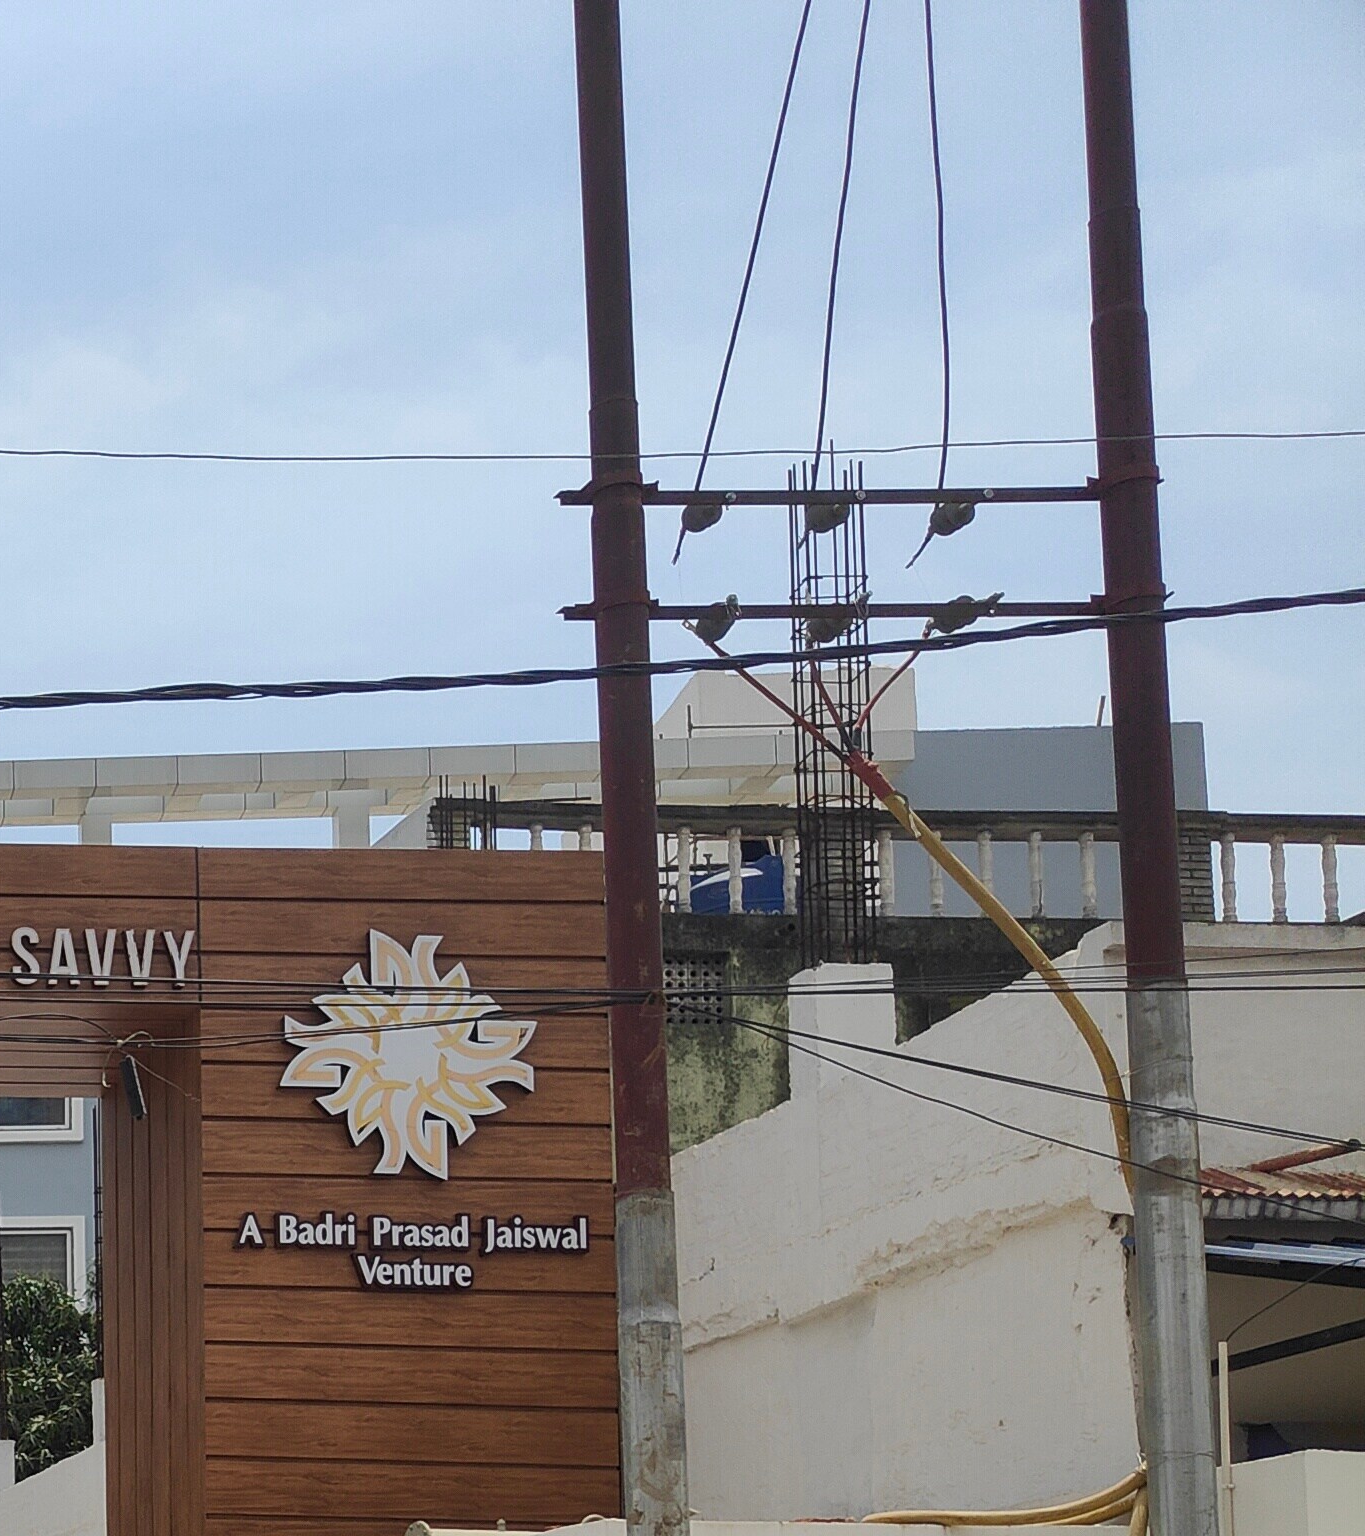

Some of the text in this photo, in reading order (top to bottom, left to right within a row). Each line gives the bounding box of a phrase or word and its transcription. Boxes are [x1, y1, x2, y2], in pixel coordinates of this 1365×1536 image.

[10, 926, 196, 988] SAVVY
[238, 1213, 589, 1254] A Badri Prasad Jaiswal
[357, 1254, 473, 1288] Venture
